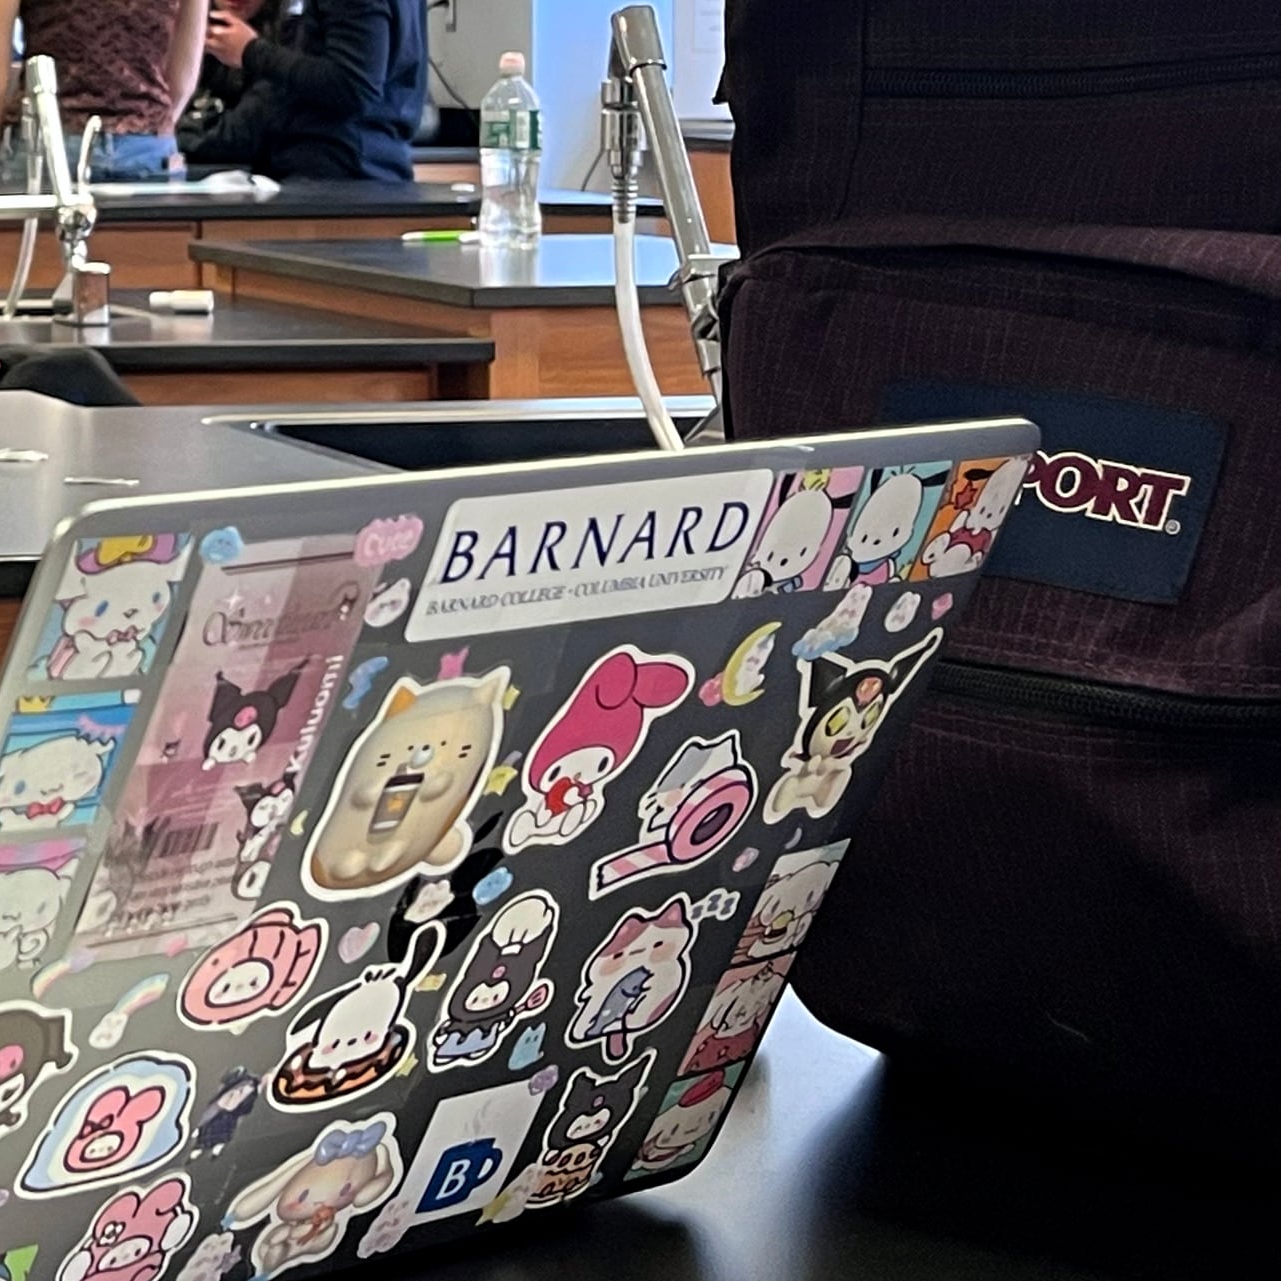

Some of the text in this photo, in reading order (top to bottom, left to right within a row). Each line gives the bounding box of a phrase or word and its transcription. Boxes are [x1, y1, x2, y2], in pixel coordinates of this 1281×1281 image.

[440, 501, 751, 585] BARNARD
[425, 565, 725, 616] BARNARD COLLEGE COLUMBIA UNIVERSITY
